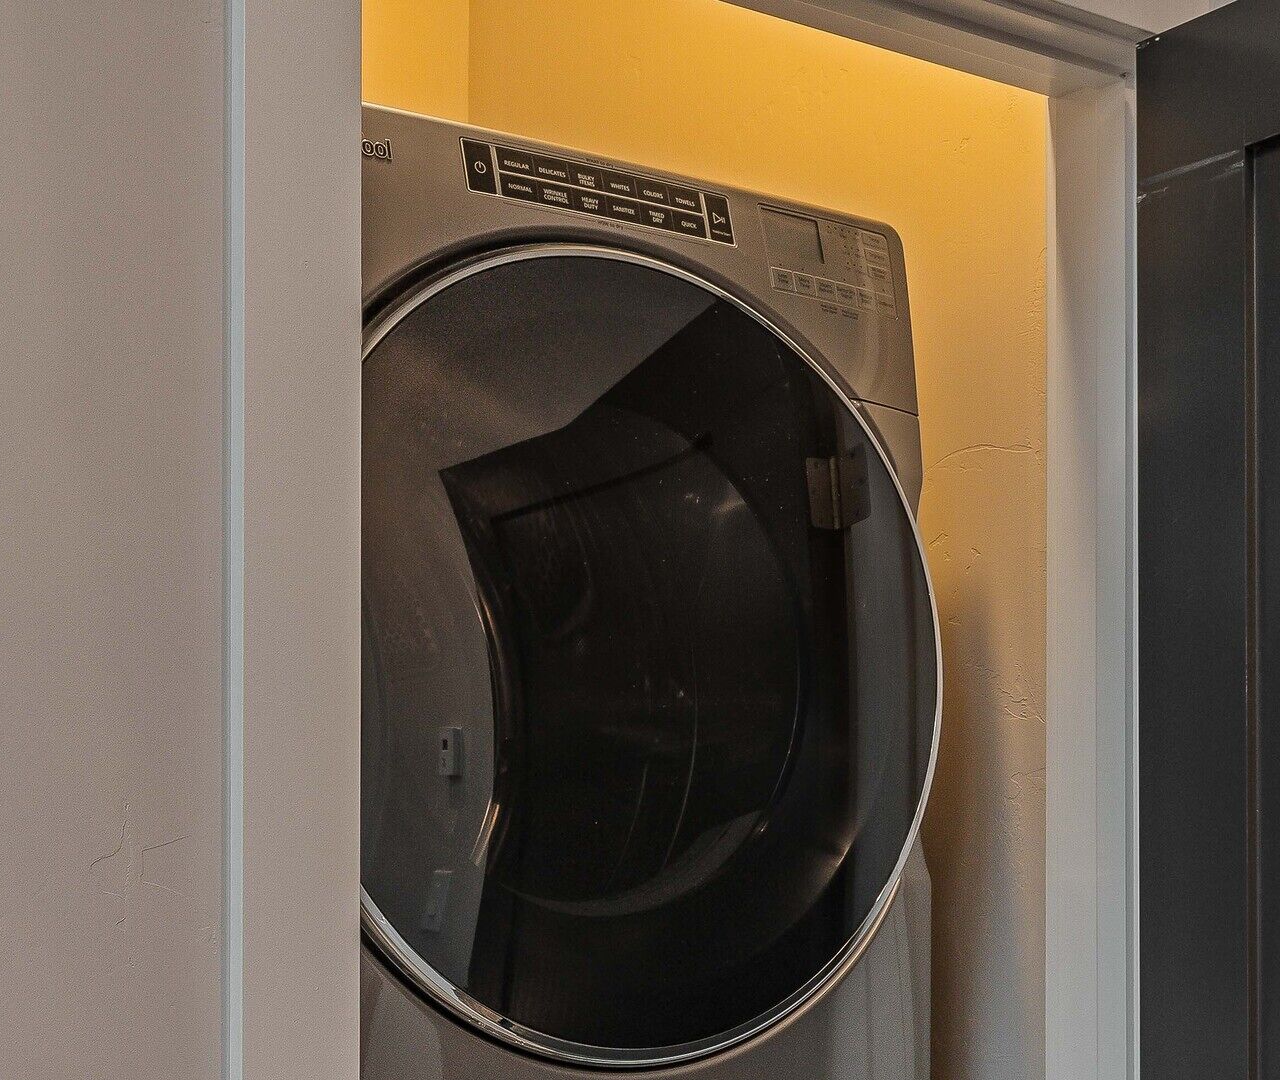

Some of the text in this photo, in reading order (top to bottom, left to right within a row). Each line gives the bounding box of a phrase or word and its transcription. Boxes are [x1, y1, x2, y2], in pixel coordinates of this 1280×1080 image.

[504, 160, 529, 170] REGULAR
[538, 167, 566, 178] DELICATES
[577, 173, 595, 181] BULKY
[579, 179, 595, 187] ITEMS
[610, 182, 630, 191] WHITES
[508, 183, 532, 193] NORMAL
[543, 188, 567, 198] WRINKLE
[643, 190, 663, 199] COLORS
[544, 194, 569, 204] CONTROL
[581, 197, 599, 205] HEAVY
[675, 197, 695, 207] TOWELS
[583, 202, 598, 210] DUTY
[612, 205, 635, 215] SANITIZE
[649, 210, 665, 219] TIMED
[681, 220, 697, 229] QUICK
